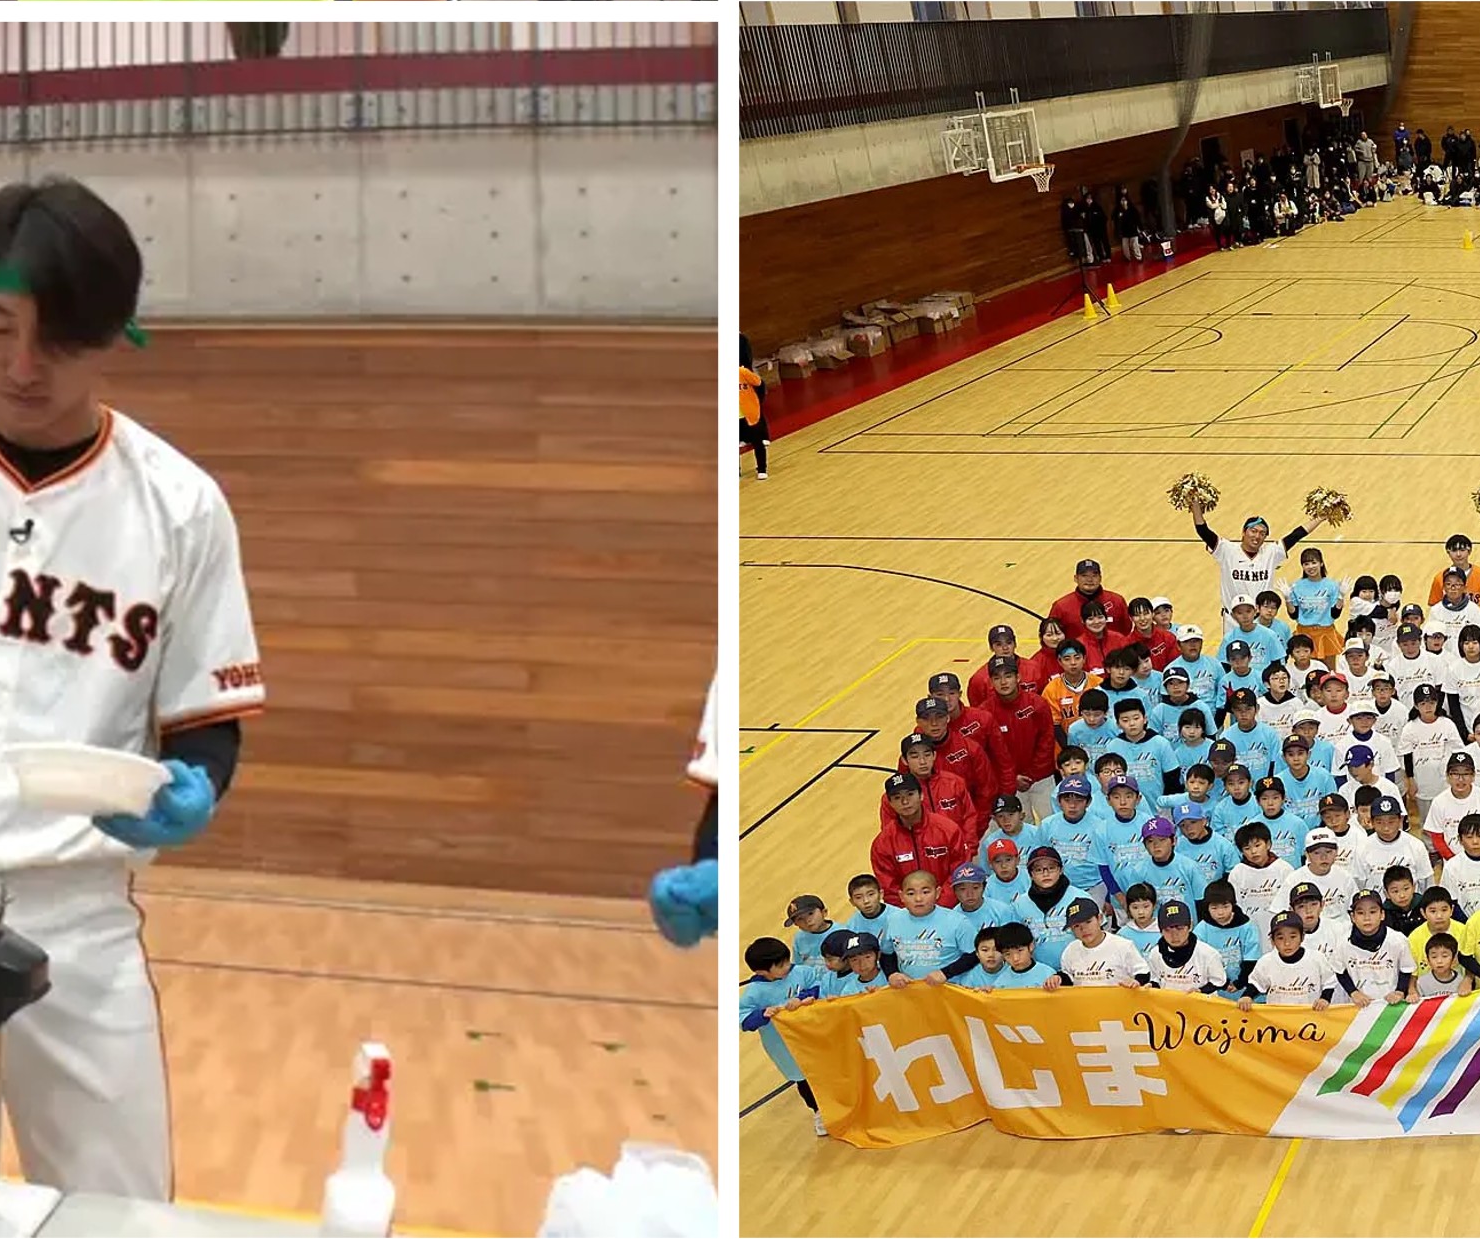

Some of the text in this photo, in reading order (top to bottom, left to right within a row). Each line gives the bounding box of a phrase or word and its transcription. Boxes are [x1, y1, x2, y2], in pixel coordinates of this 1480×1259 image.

[1231, 568, 1270, 582] GIANTS
[1133, 1010, 1326, 1055] Wajima
[857, 1014, 1169, 1113] わじま
